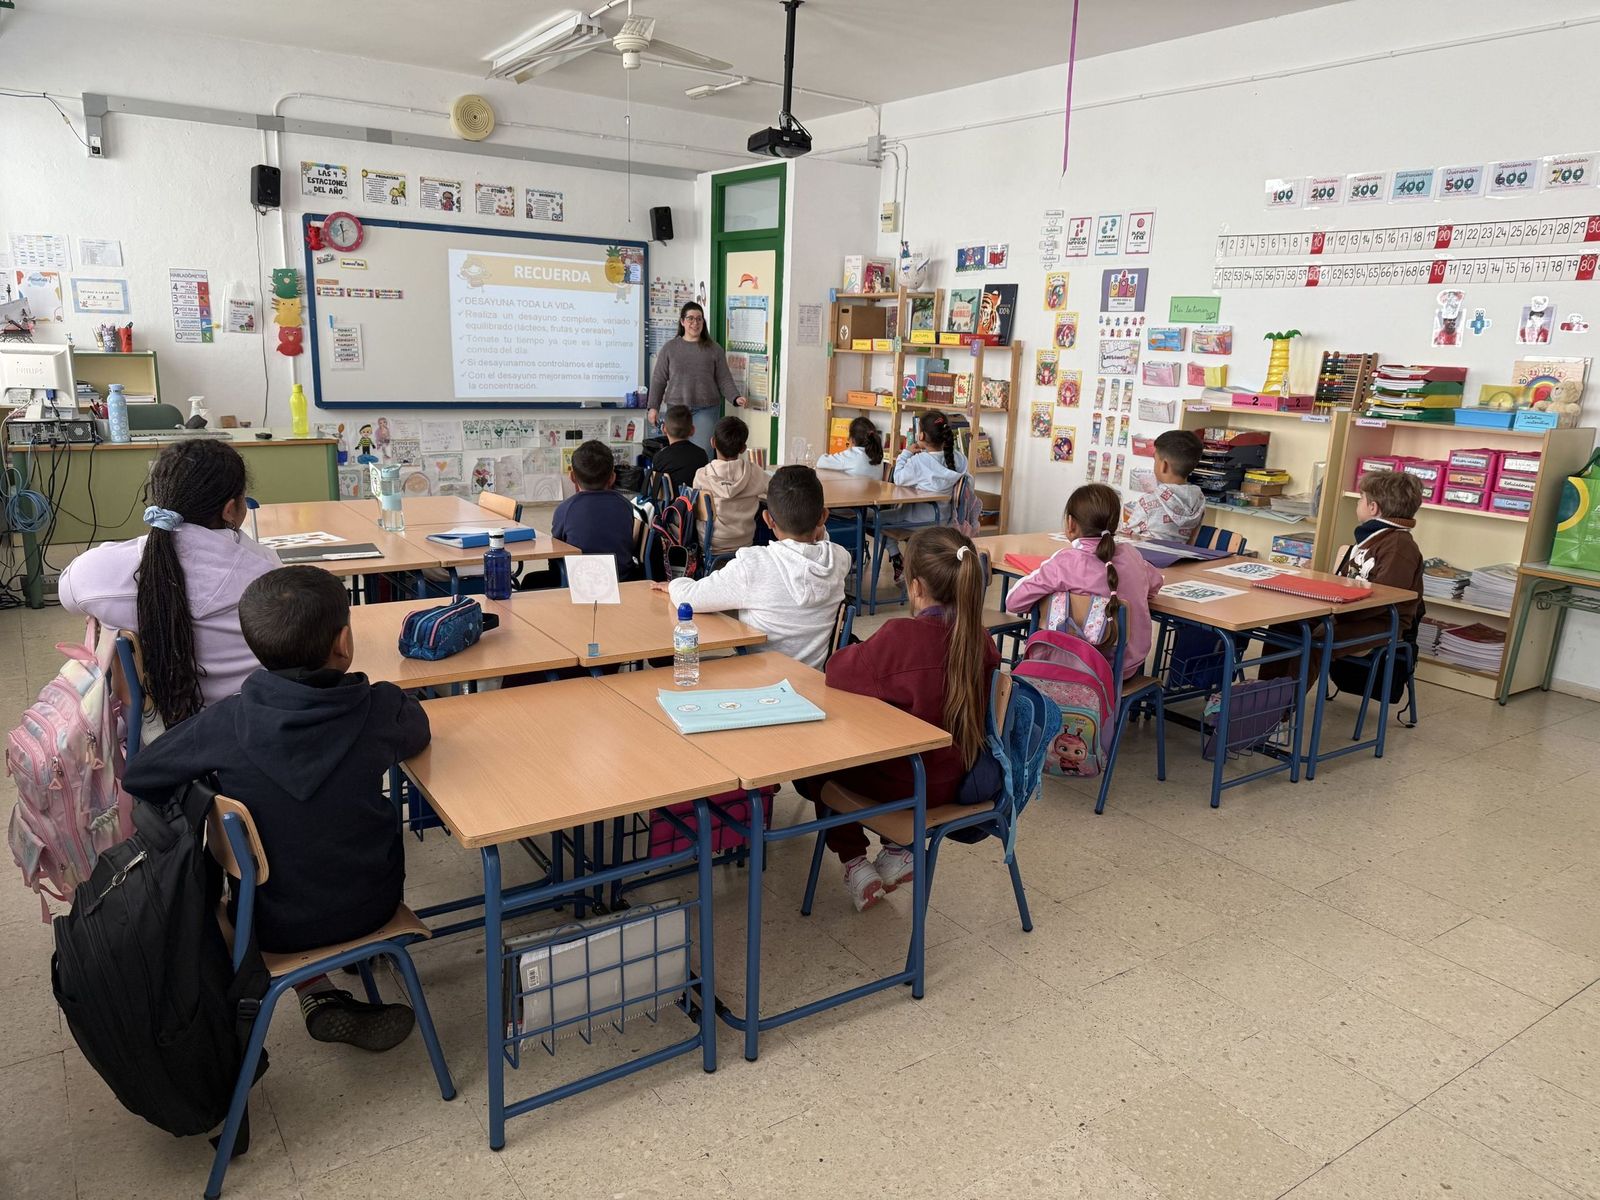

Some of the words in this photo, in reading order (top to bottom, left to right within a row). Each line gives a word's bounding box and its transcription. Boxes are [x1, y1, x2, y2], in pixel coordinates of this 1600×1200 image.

[308, 177, 347, 187] ESTACIONES
[1495, 170, 1528, 185] 600
[1549, 167, 1584, 184] 700
[329, 186, 342, 195] AÑO
[1352, 183, 1378, 198] 300
[1397, 180, 1425, 193] 400
[1444, 178, 1474, 191] 500
[1272, 190, 1293, 202] 100
[1311, 186, 1335, 200] 200
[1314, 237, 1322, 247] 10
[1327, 236, 1334, 246] 11
[1339, 235, 1346, 245] 12
[1350, 235, 1358, 245] 13
[1362, 235, 1370, 244] 14
[1375, 234, 1383, 244] 15
[1388, 233, 1396, 244] 16
[1400, 232, 1408, 242] 17
[1413, 231, 1422, 242] 18
[1427, 231, 1436, 241] 19
[1438, 230, 1450, 241] 20
[1454, 229, 1464, 240] 21
[1467, 228, 1478, 239] 22
[1481, 227, 1492, 239] 23
[1496, 226, 1506, 238] 24
[1511, 226, 1522, 237] 25
[1525, 225, 1538, 236] 26
[1541, 224, 1553, 235] 27
[1557, 223, 1570, 234] 28
[1573, 222, 1586, 234] 29
[514, 265, 592, 283] RECUERDA
[1224, 271, 1231, 280] 52
[1234, 271, 1242, 280] 53
[1244, 271, 1252, 280] 54
[1255, 271, 1262, 280] 55
[1265, 271, 1274, 280] 56
[1276, 270, 1284, 280] 57
[1287, 270, 1296, 280] 58
[1298, 270, 1307, 280] 59
[1309, 270, 1319, 280] 60
[1321, 269, 1330, 279] 61
[1333, 268, 1341, 279] 62
[1344, 268, 1354, 279] 63
[1356, 268, 1365, 278] 64
[1368, 267, 1378, 278] 65
[1381, 267, 1391, 278] 66
[1393, 266, 1404, 277] 67
[1406, 266, 1417, 276] 68
[1420, 265, 1430, 276] 69
[1434, 265, 1445, 275] 70
[1448, 264, 1457, 275] 71
[1462, 264, 1472, 274] 72
[1476, 263, 1486, 274] 73
[1491, 263, 1500, 274] 74
[1505, 262, 1516, 273] 75
[1520, 262, 1530, 273] 76
[1535, 261, 1546, 272] 77
[1550, 261, 1562, 272] 78
[1567, 260, 1578, 271] 79
[1580, 259, 1595, 271] 80
[464, 296, 513, 306] DESAYUNA
[518, 300, 540, 308] TODA
[465, 310, 497, 318] Realiza
[519, 312, 557, 321] desayuno
[561, 314, 599, 324] completo,
[603, 316, 630, 325] variado
[465, 322, 513, 331] equilibrado
[551, 324, 573, 333] frutas
[466, 335, 499, 343] Tómate
[517, 337, 544, 345] tiempo
[605, 340, 633, 348] primera
[466, 346, 498, 354] comida
[478, 360, 535, 368] desayunamos
[498, 372, 536, 380] desayuno
[1252, 396, 1258, 406] 2
[1295, 398, 1300, 407] 2
